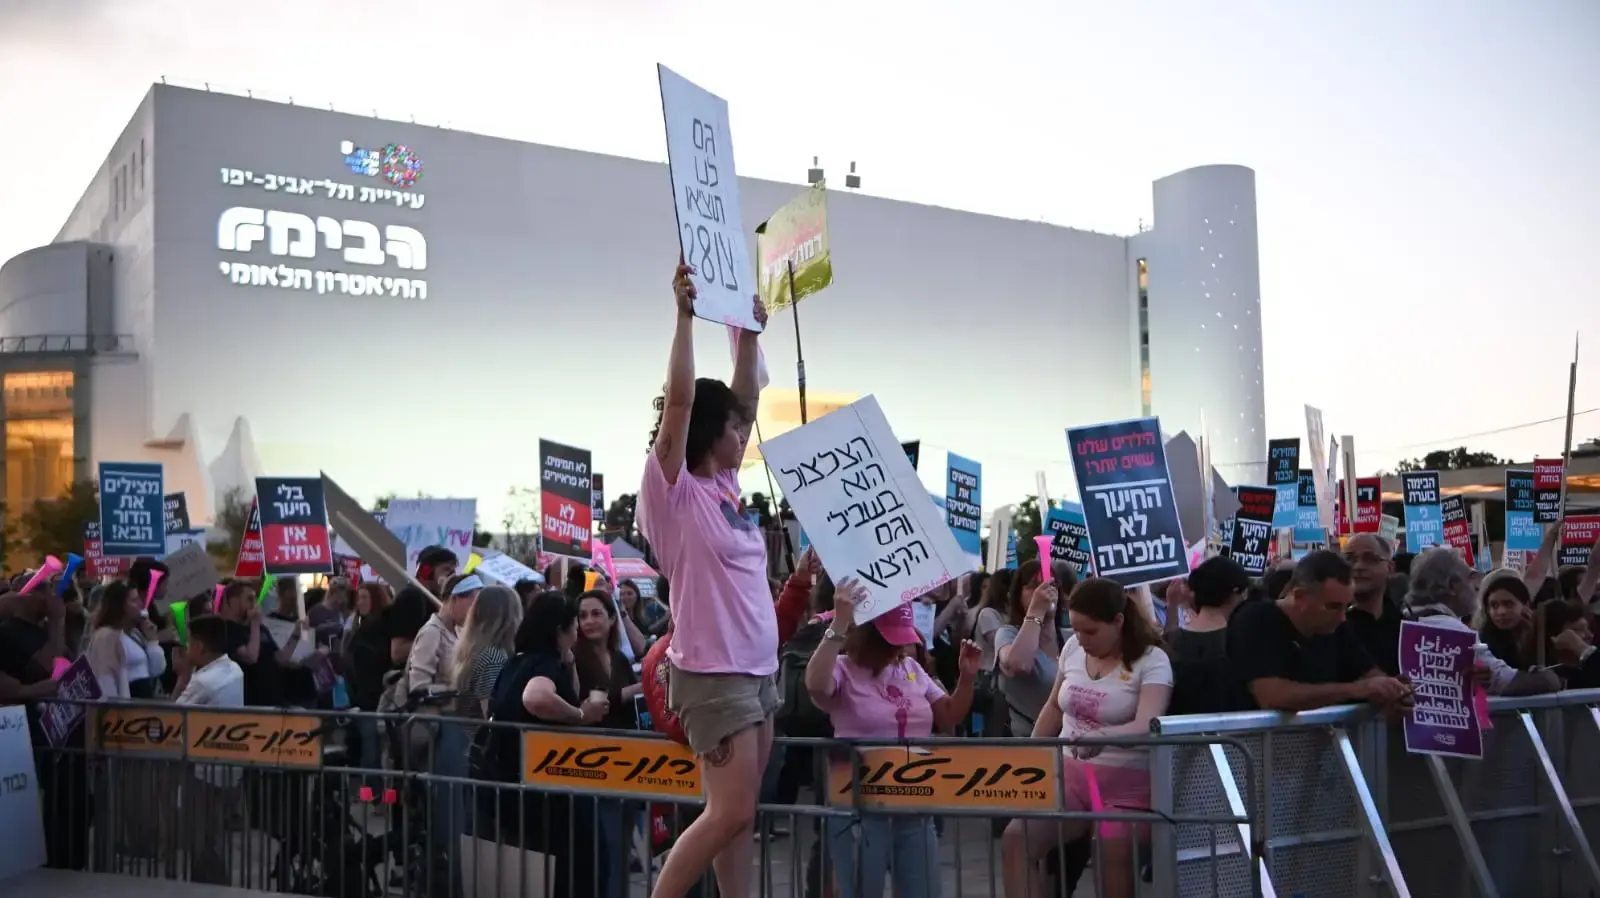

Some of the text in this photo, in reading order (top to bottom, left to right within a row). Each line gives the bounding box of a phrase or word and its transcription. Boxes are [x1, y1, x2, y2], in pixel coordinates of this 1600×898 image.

[692, 118, 716, 156] גם
[694, 155, 719, 188] לנו
[220, 167, 425, 209] עיריית תל-אביב-יפו
[218, 206, 428, 270] הבימה
[218, 261, 427, 300] התיאטרון הלאומי
[1077, 432, 1156, 456] הילדים שלנו
[576, 462, 587, 474] לא
[780, 436, 874, 493] הצלצול
[1085, 452, 1155, 476] שווים יותר!
[104, 476, 160, 496] מצילים
[578, 477, 590, 489] לא
[840, 463, 886, 498] הוא
[1406, 477, 1436, 490] הבימה
[277, 484, 304, 500] בלי
[1358, 487, 1374, 501] די
[120, 495, 145, 509] את
[272, 502, 312, 519] חינוך
[1094, 486, 1162, 518] החינוך
[112, 510, 151, 526] הדור
[560, 504, 576, 522] לא
[826, 490, 905, 536] בשבילי
[112, 524, 153, 540] הבא!
[544, 514, 589, 542] שותקים!
[874, 514, 915, 546] וגם
[1117, 511, 1148, 538] לא
[1240, 522, 1268, 540] החינוך
[1564, 521, 1600, 530] הממשל
[283, 526, 308, 545] אין
[1060, 535, 1077, 546] את
[274, 544, 321, 561] עתיד.
[1098, 534, 1176, 569] למכירה
[1244, 538, 1259, 552] לא
[856, 540, 929, 588] הקיצוץ
[1231, 552, 1266, 568] למכירה
[1442, 644, 1462, 656] من
[1420, 653, 1454, 670] למען
[1416, 710, 1467, 729] והמורים
[676, 778, 696, 789] ציוד
[972, 788, 1046, 800] ציוד לארועים
